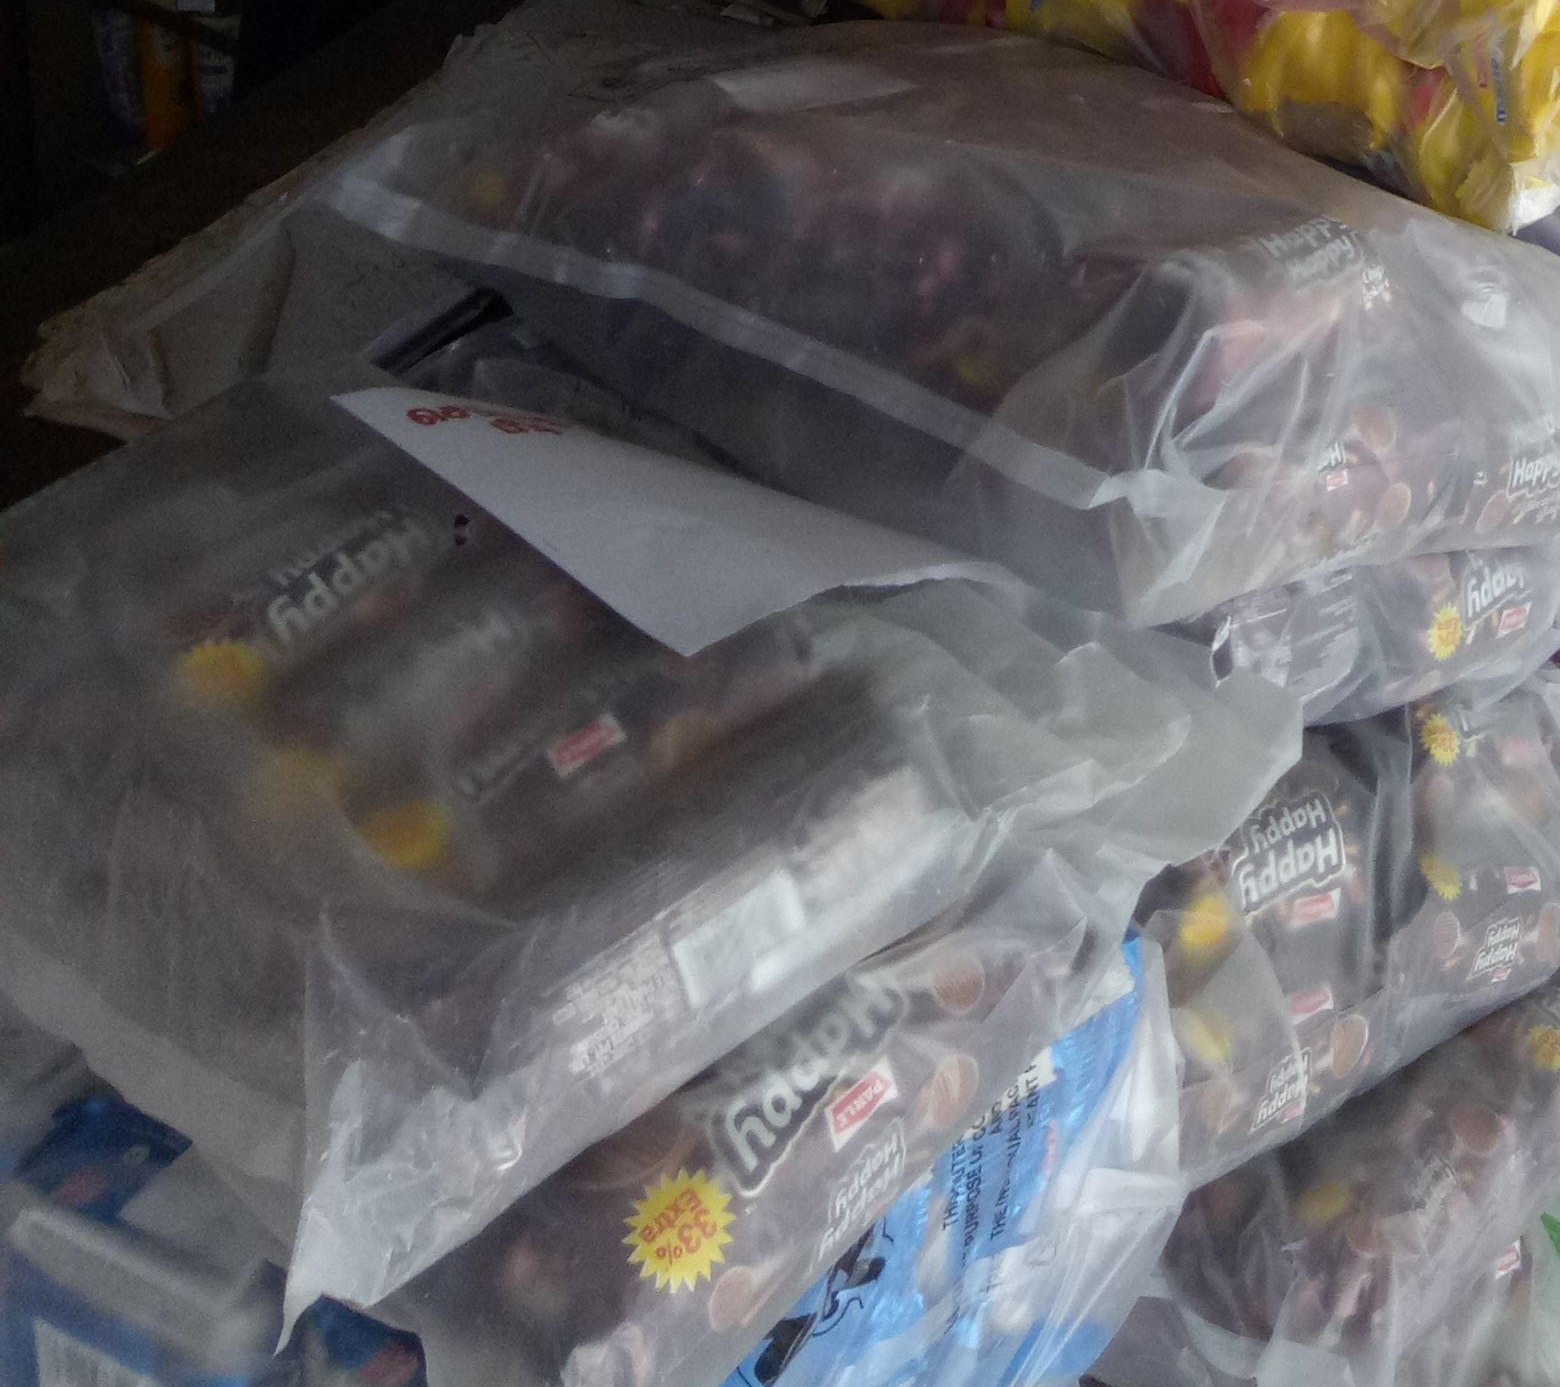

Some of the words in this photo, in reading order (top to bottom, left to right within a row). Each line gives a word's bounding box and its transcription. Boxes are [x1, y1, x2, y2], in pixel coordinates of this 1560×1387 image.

[1249, 797, 1329, 856] Happy
[1237, 831, 1340, 913] Happy
[833, 1077, 888, 1130] PARLE
[640, 1190, 702, 1244] Extra
[654, 1210, 717, 1262] 33%
